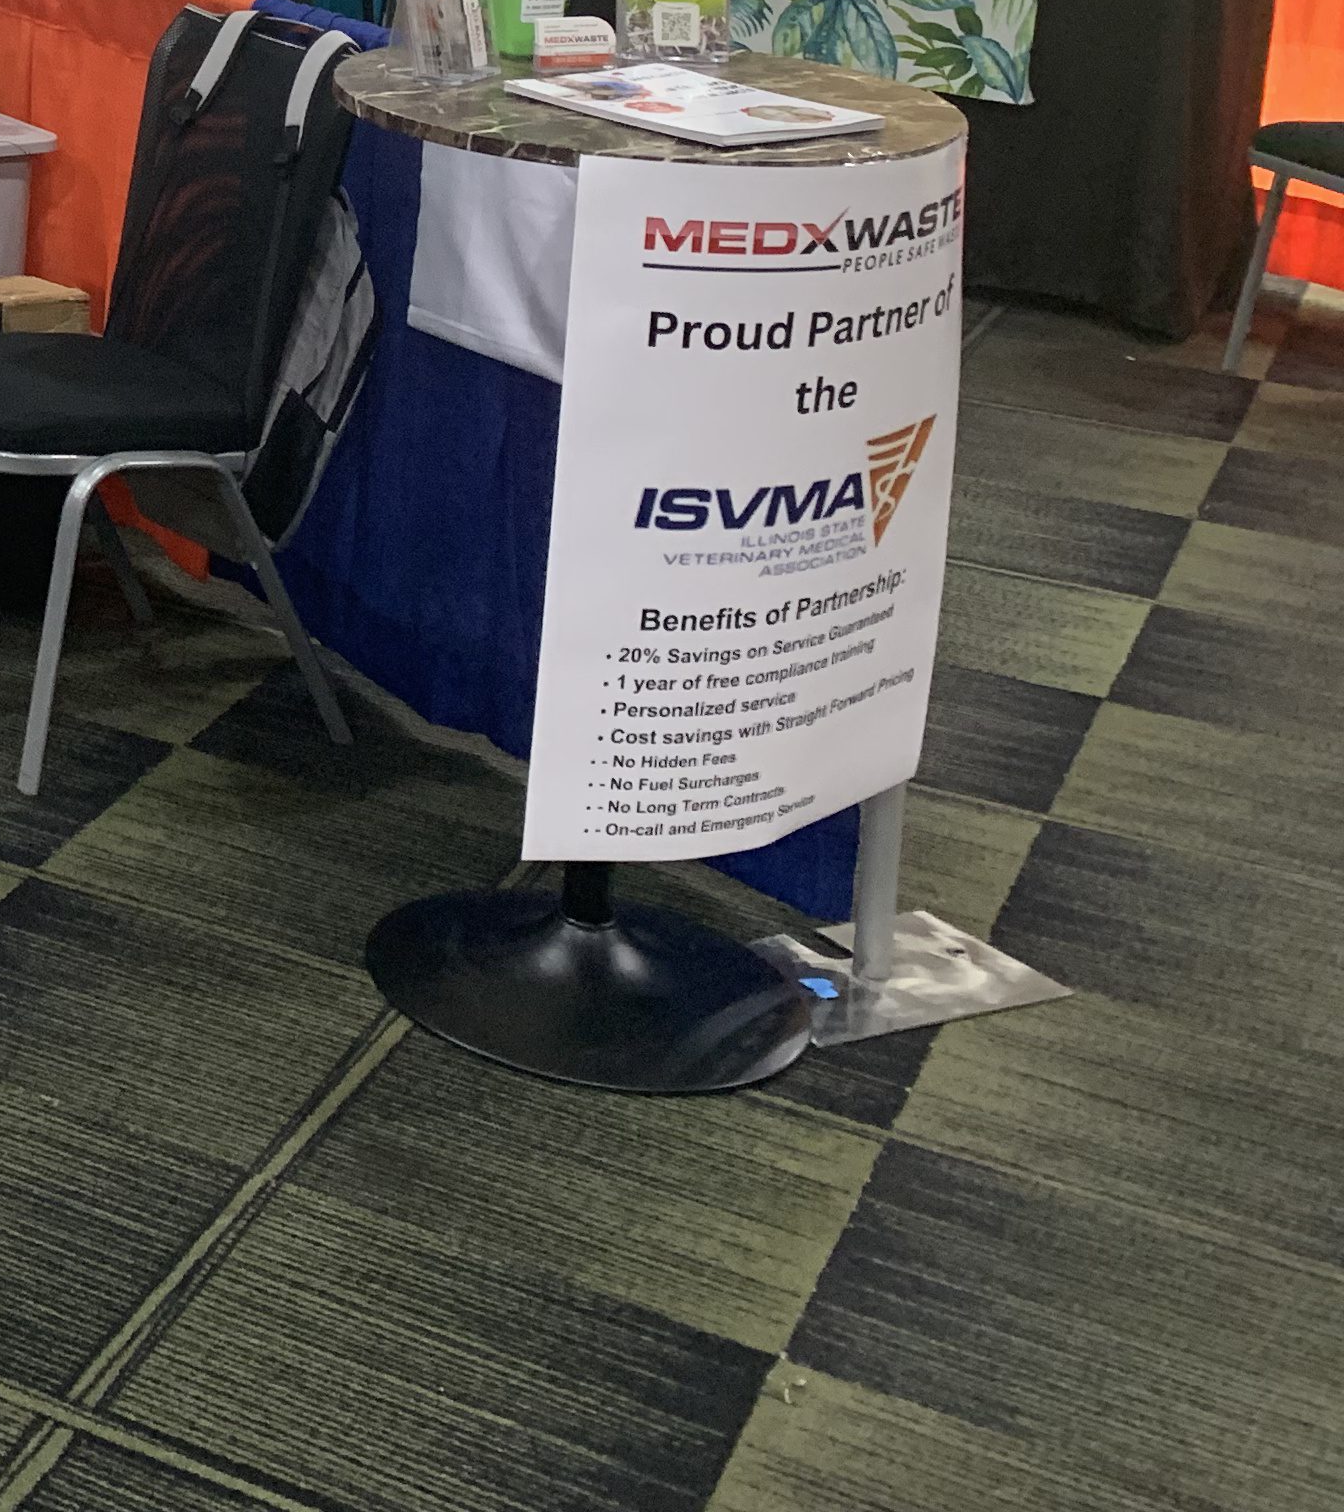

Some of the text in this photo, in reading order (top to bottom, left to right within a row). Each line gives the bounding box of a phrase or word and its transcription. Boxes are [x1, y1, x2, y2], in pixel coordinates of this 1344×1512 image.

[644, 187, 962, 256] MEDXWASTE
[647, 272, 955, 351] Proud Partner of
[795, 376, 858, 415] the
[634, 472, 865, 531] ISVMA
[741, 515, 866, 548] ILLINOIS STATE
[663, 547, 794, 567] VETERINARY
[639, 566, 907, 633] Benefits of Partnership:
[618, 633, 826, 665] 20% Savings Service
[634, 674, 740, 694] year free
[613, 691, 796, 719] Personalized service
[610, 727, 733, 747] Cost savings
[612, 751, 737, 769] No Hidden Fees
[610, 776, 673, 792] No Fuel
[608, 797, 719, 817] No Long Term
[605, 822, 697, 837] On-call and
